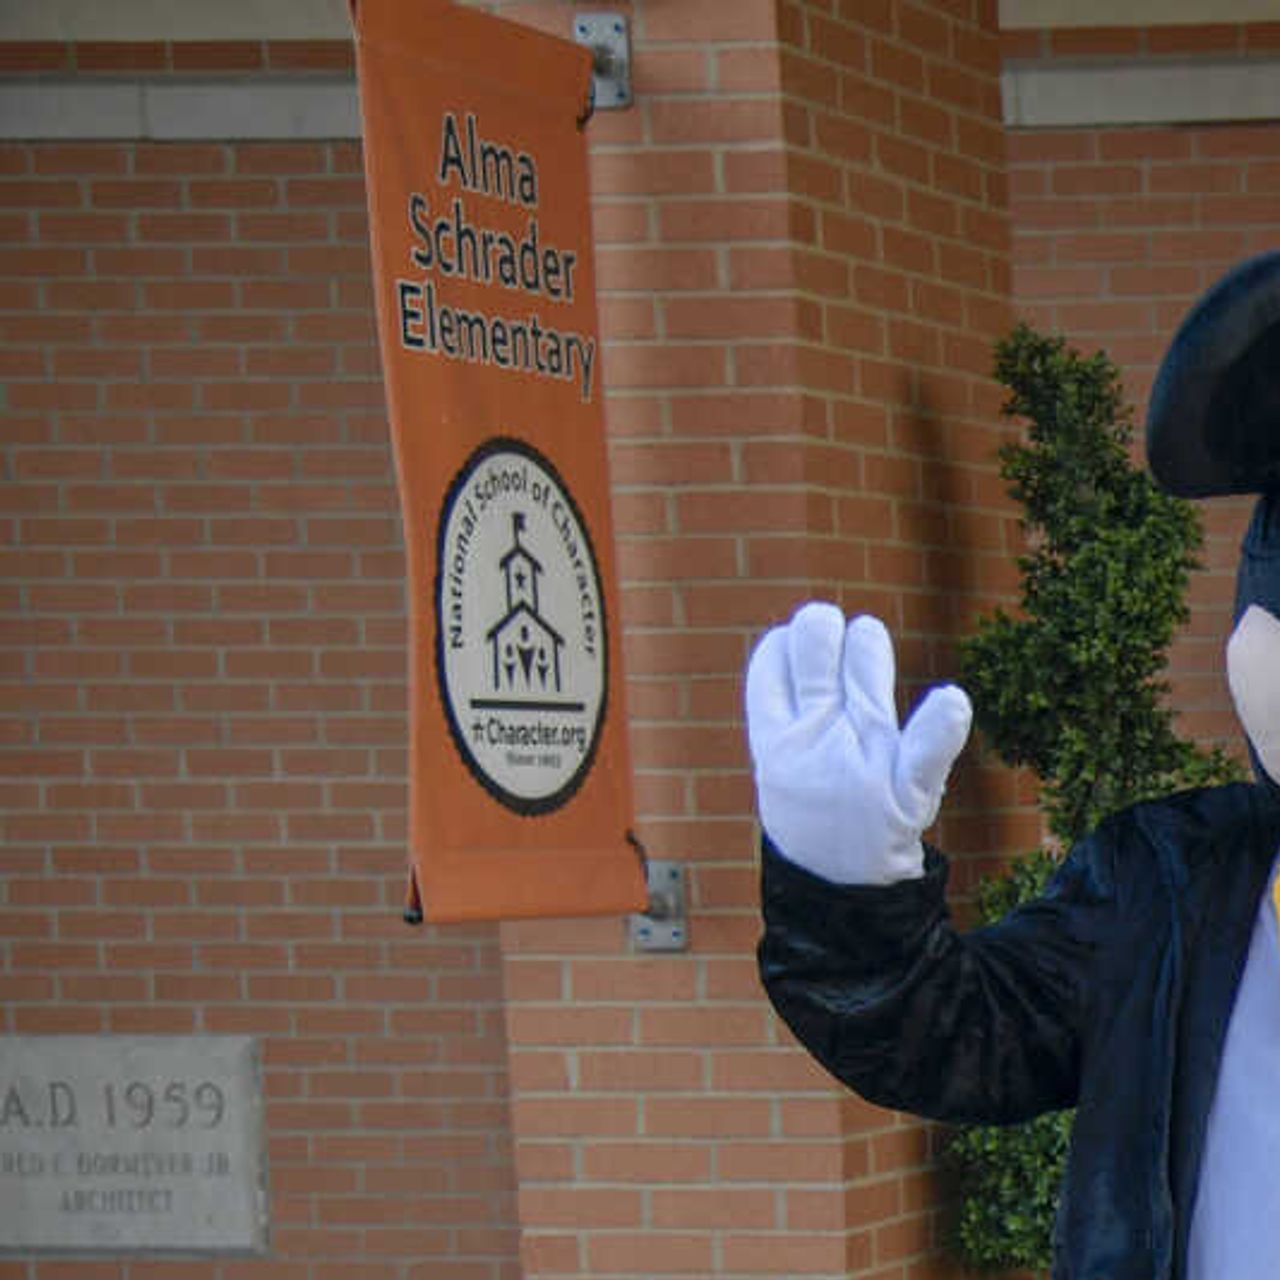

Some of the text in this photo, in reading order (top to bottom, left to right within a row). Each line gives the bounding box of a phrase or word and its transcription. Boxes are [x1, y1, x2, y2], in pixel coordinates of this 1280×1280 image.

[440, 114, 537, 208] Alma
[409, 193, 576, 303] Schrader
[397, 280, 595, 402] Elementary
[449, 467, 595, 659] National School of Character
[487, 717, 586, 752] Character.org
[104, 1080, 226, 1130] 1959
[61, 1188, 174, 1213] ARCHITECT
